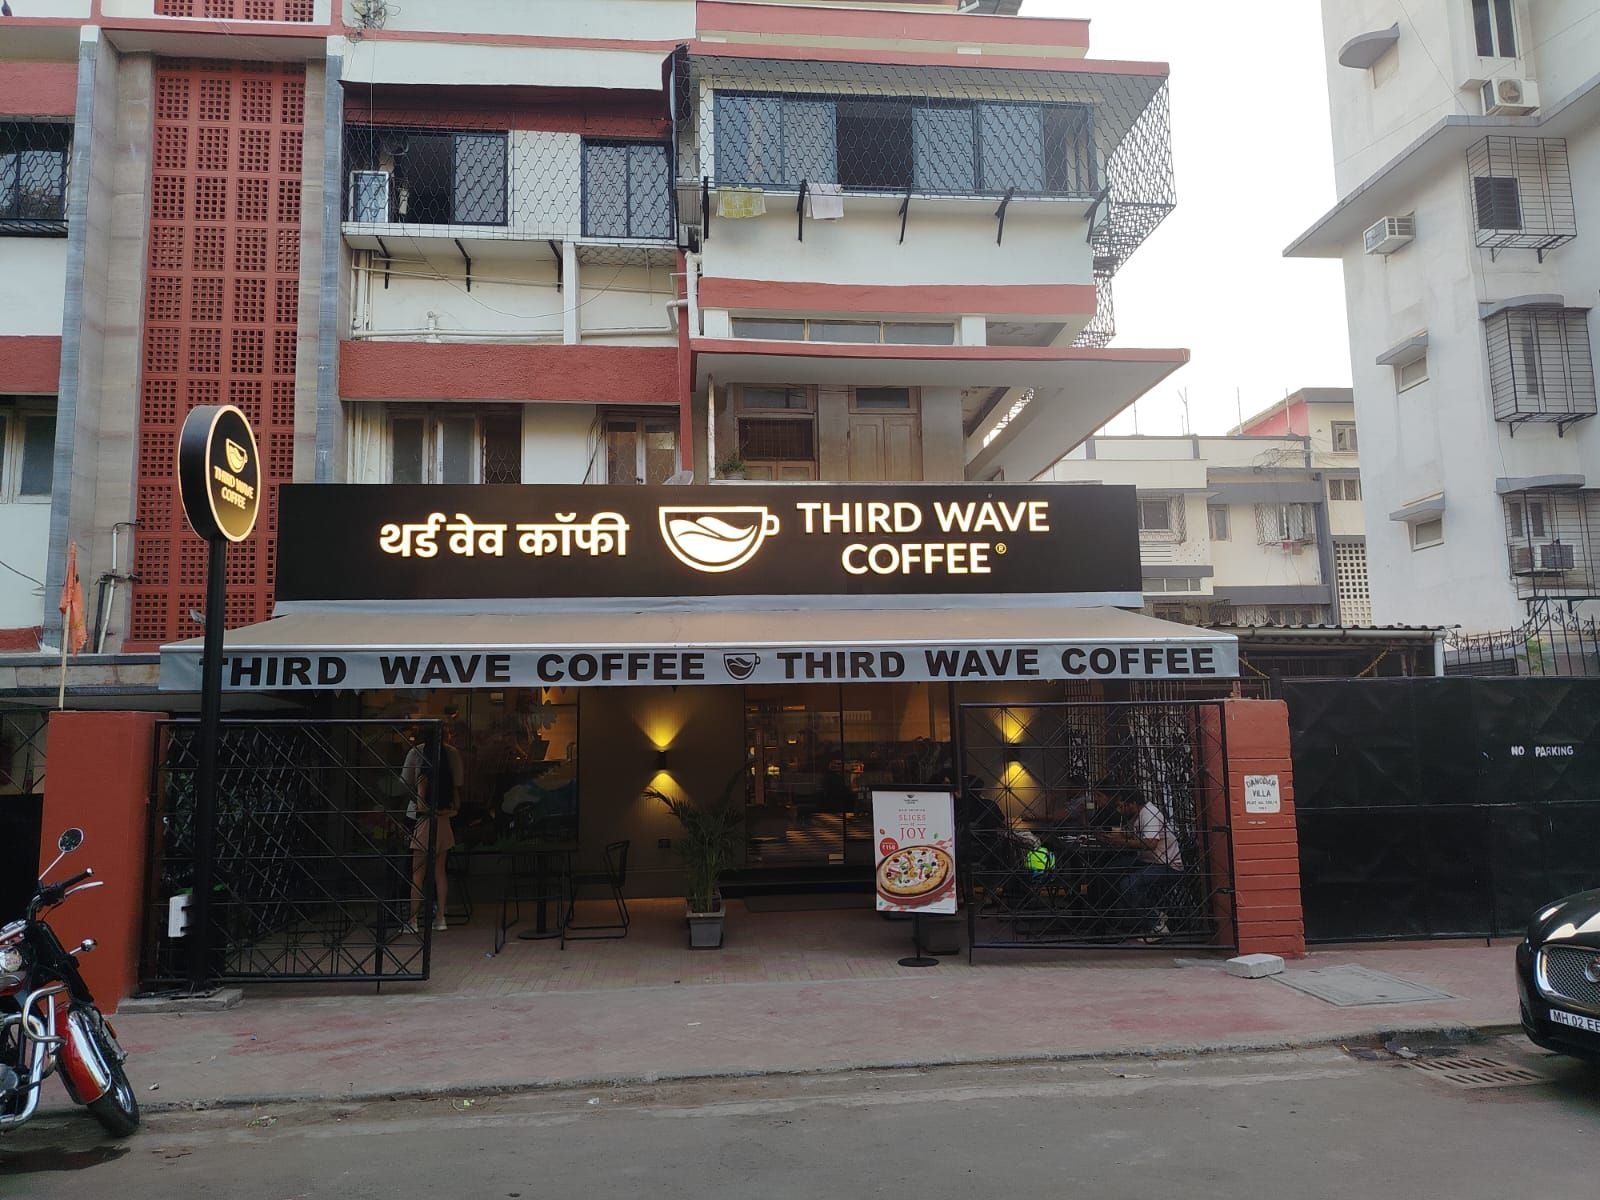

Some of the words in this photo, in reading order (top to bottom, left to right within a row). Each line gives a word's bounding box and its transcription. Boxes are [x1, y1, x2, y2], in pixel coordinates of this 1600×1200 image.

[796, 502, 922, 533] THIRD
[933, 501, 1050, 532] WAVE
[379, 512, 446, 558] थर्ड
[446, 513, 507, 556] वेव
[516, 511, 630, 556] कॉफी
[380, 654, 511, 685] WAVE
[536, 652, 705, 683] COFFEE
[776, 651, 905, 680] THIRD
[924, 648, 1040, 677] WAVE
[1061, 647, 1216, 676] COFFEE
[1511, 745, 1525, 757] NO
[1535, 745, 1574, 758] PARKING
[899, 827, 927, 841] JOY
[1553, 1009, 1569, 1025] MH
[1571, 1014, 1585, 1030] 02
